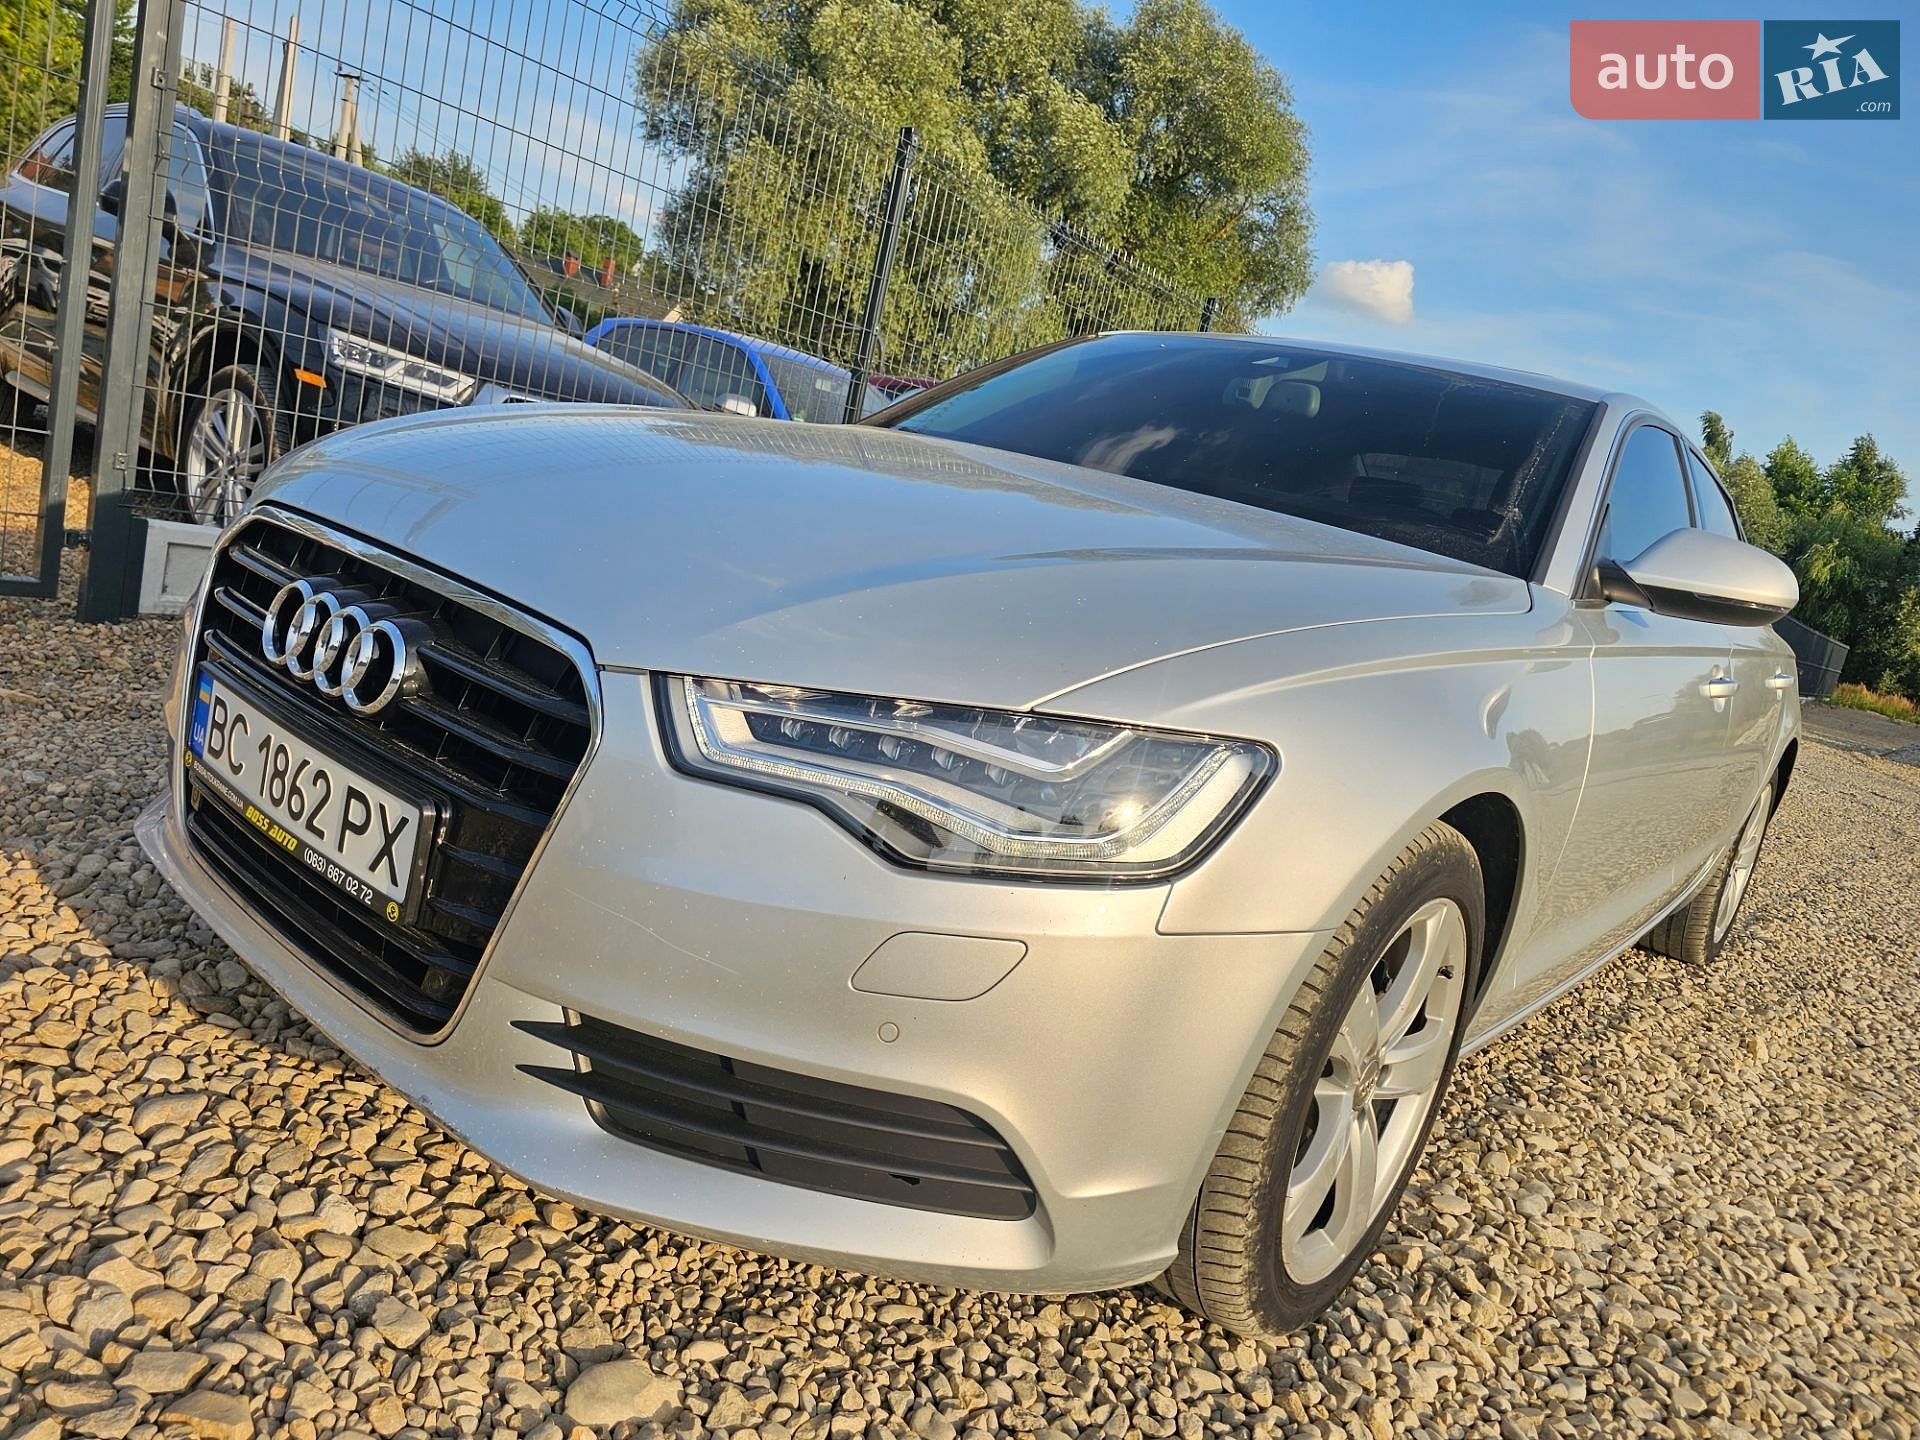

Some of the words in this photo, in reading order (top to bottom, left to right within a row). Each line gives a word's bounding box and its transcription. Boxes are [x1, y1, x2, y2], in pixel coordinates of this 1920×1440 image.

[193, 721, 205, 748] UA
[207, 694, 250, 776] BC
[258, 733, 334, 841] 1862
[338, 784, 410, 888] PX
[245, 805, 271, 830] BOSS
[303, 847, 327, 873] (063)
[327, 864, 346, 885] 667
[345, 876, 359, 896] 02
[359, 885, 374, 905] 72
